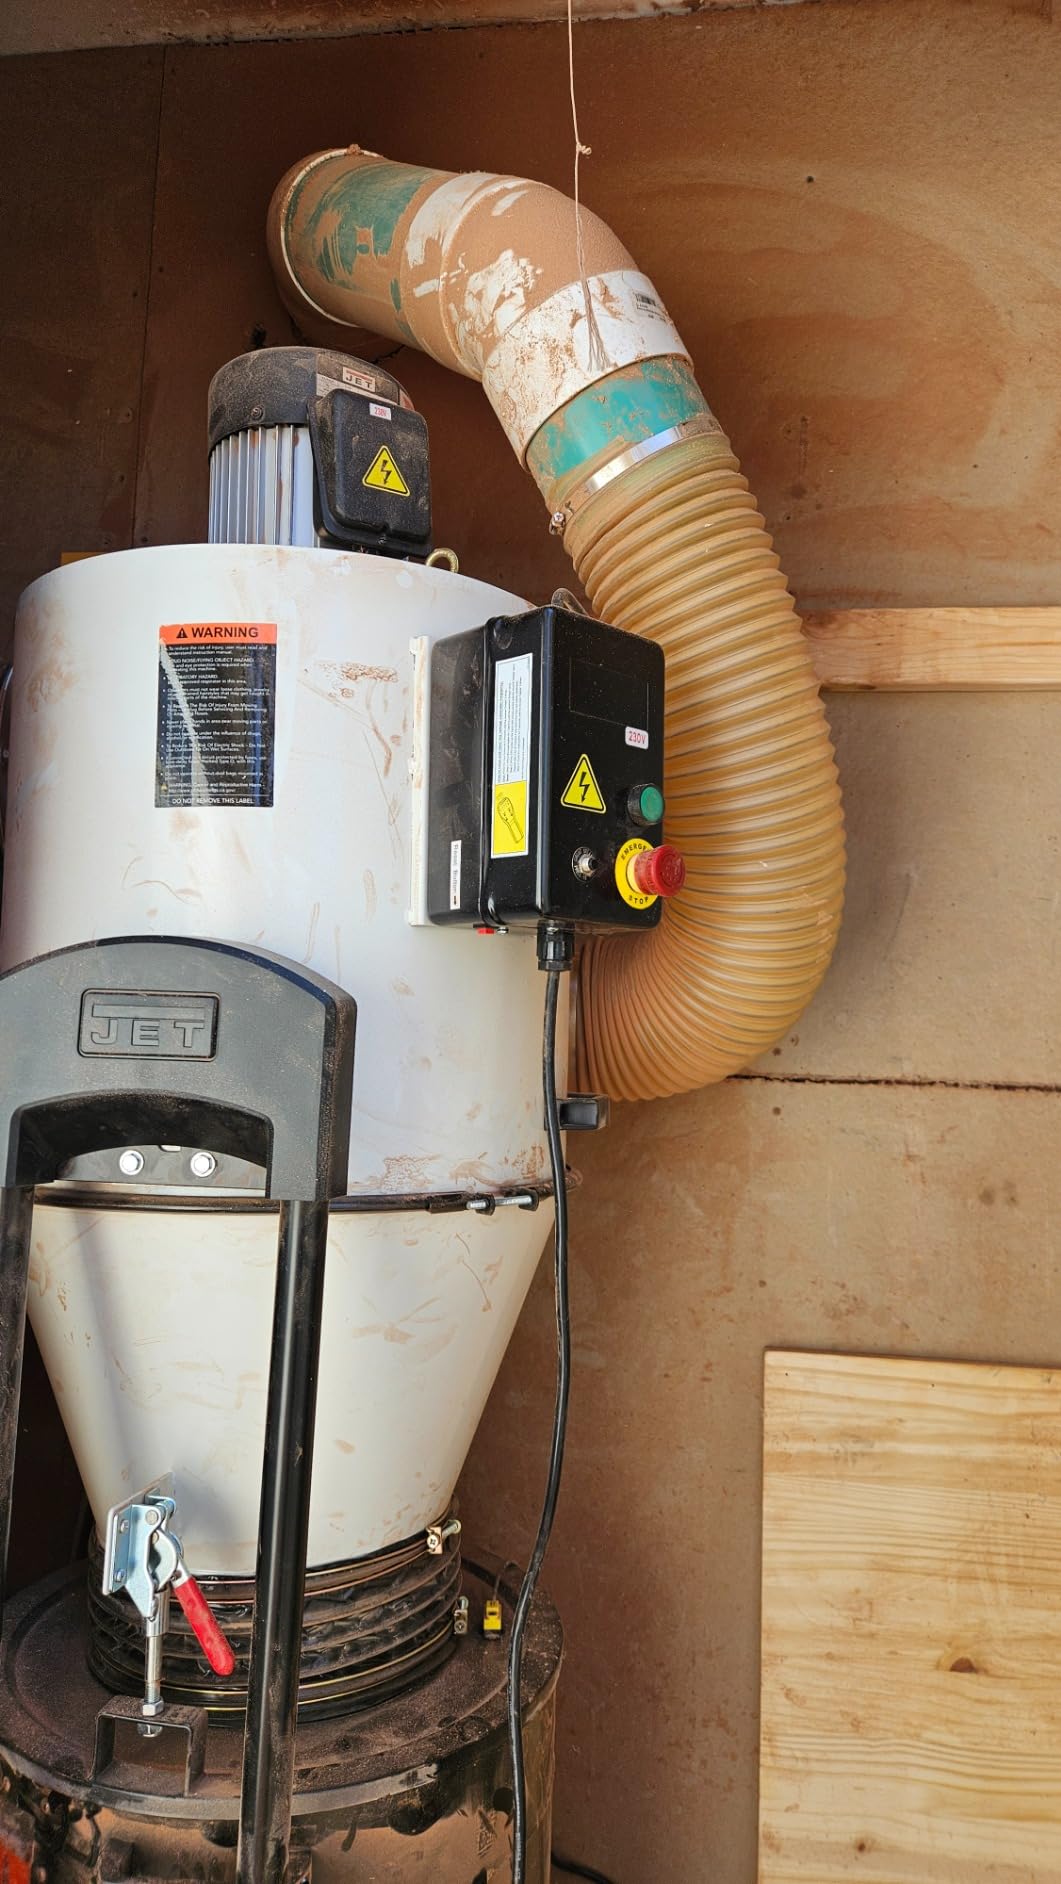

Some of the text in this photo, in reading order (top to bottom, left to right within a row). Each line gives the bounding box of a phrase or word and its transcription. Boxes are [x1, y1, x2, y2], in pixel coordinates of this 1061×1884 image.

[346, 376, 372, 388] JET
[191, 627, 259, 638] WARNING
[629, 731, 646, 744] 230V
[628, 895, 649, 905] STOP
[91, 1019, 205, 1048] JET
